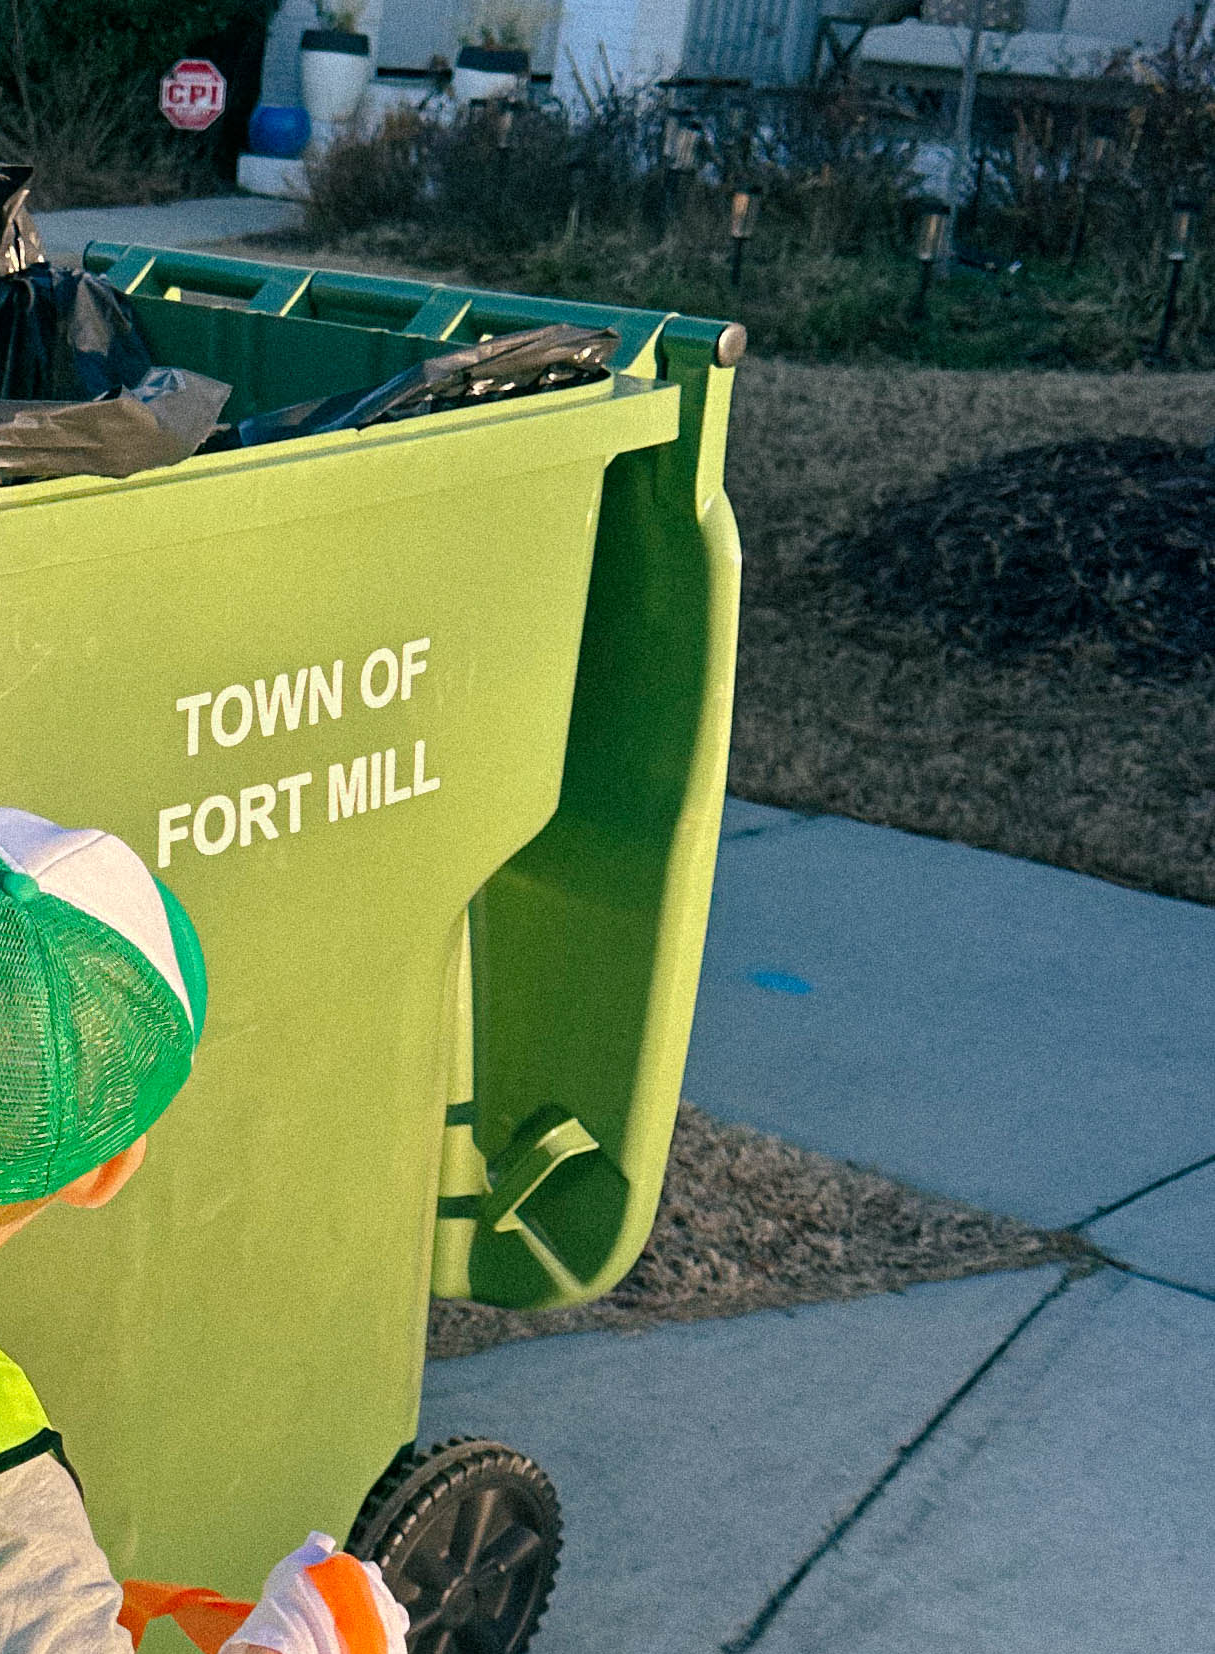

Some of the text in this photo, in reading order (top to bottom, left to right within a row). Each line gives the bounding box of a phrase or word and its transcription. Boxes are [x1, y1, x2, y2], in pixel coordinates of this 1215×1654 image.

[168, 84, 218, 105] CPI
[176, 637, 431, 756] TOWN OF
[157, 740, 440, 868] FORT MILL
